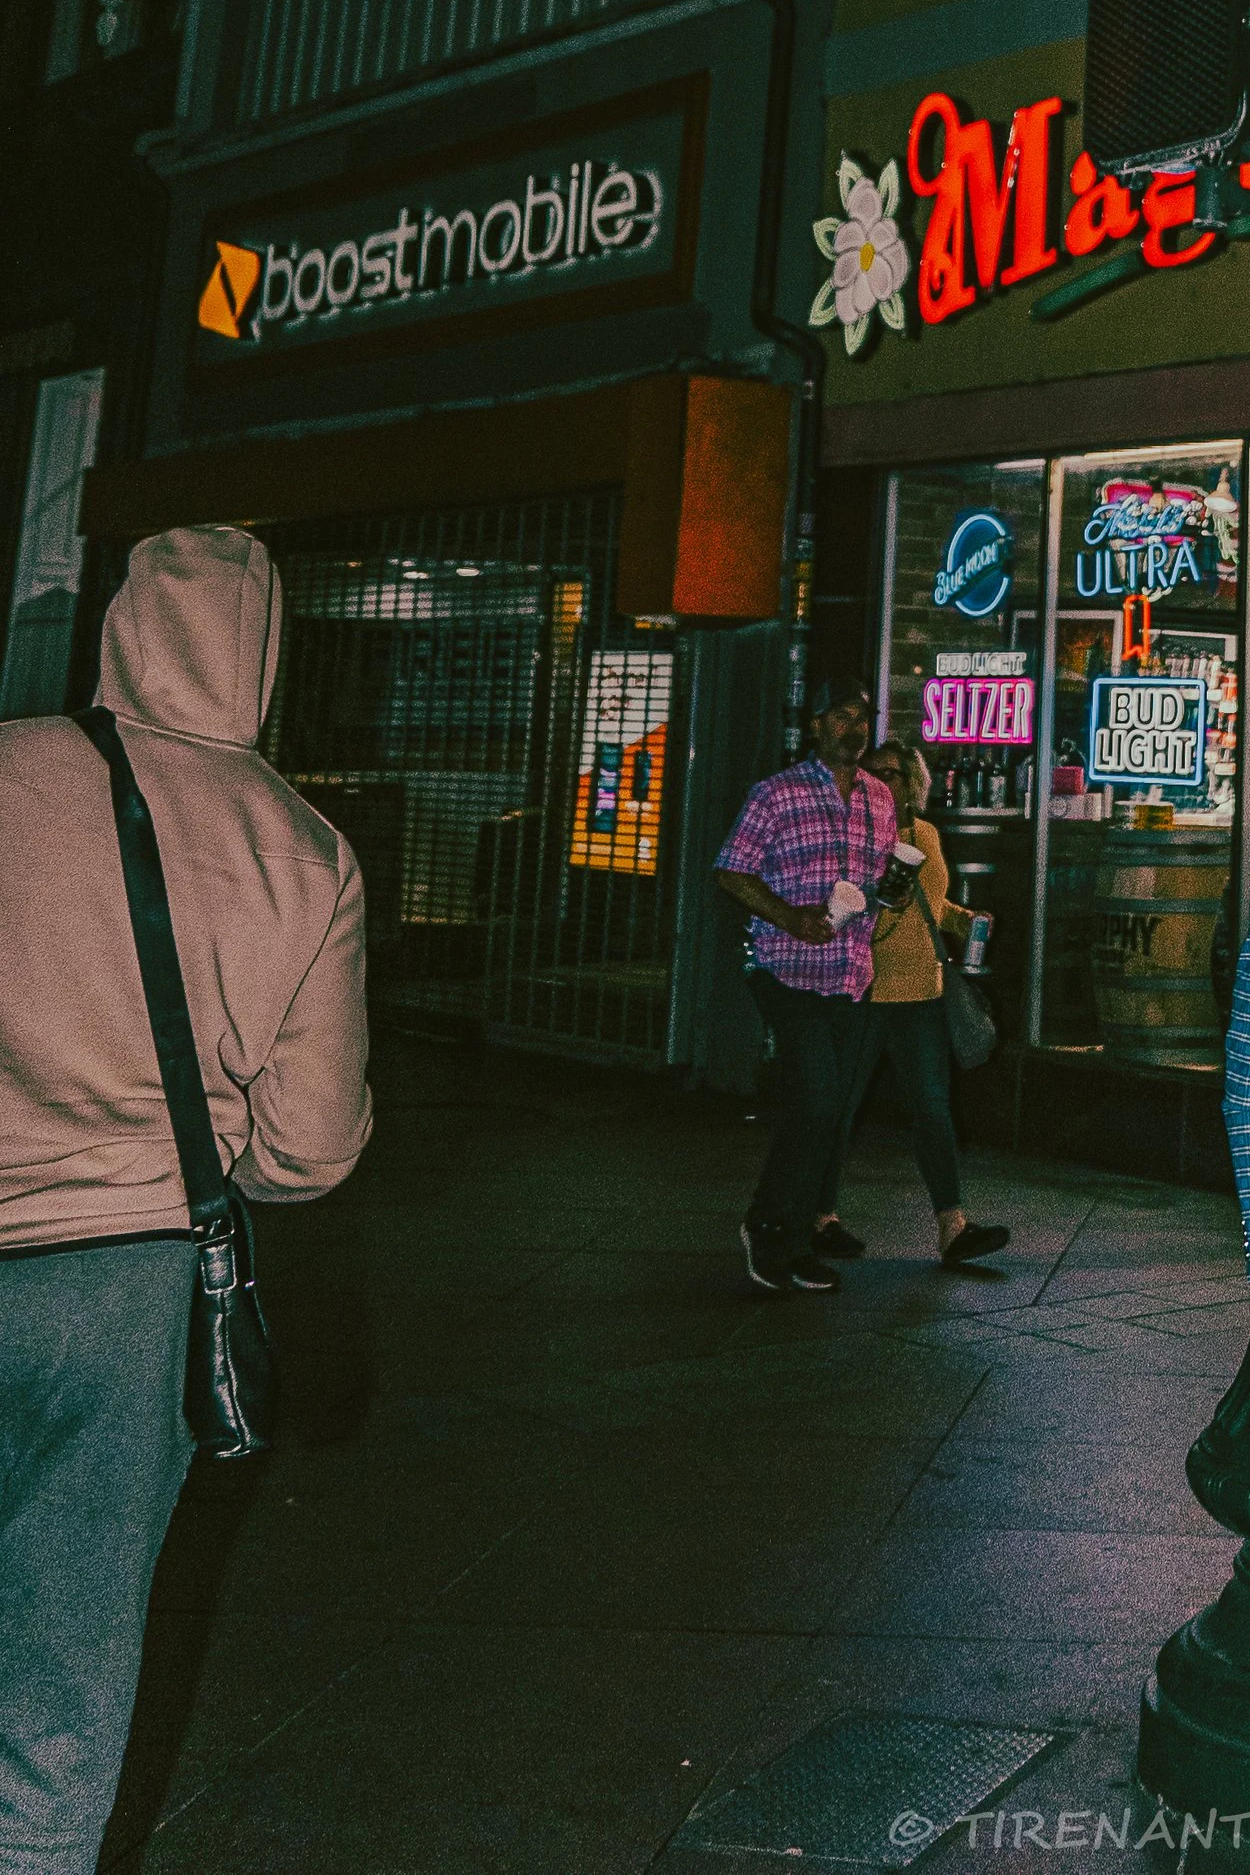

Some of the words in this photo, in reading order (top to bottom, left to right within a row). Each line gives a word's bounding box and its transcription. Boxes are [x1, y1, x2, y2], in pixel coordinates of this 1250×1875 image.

[935, 565, 967, 606] BLUE
[1075, 541, 1201, 597] ULTRA
[923, 679, 1033, 743] SELTZER
[1110, 686, 1184, 731] BUD
[1095, 728, 1197, 774] LIGHT
